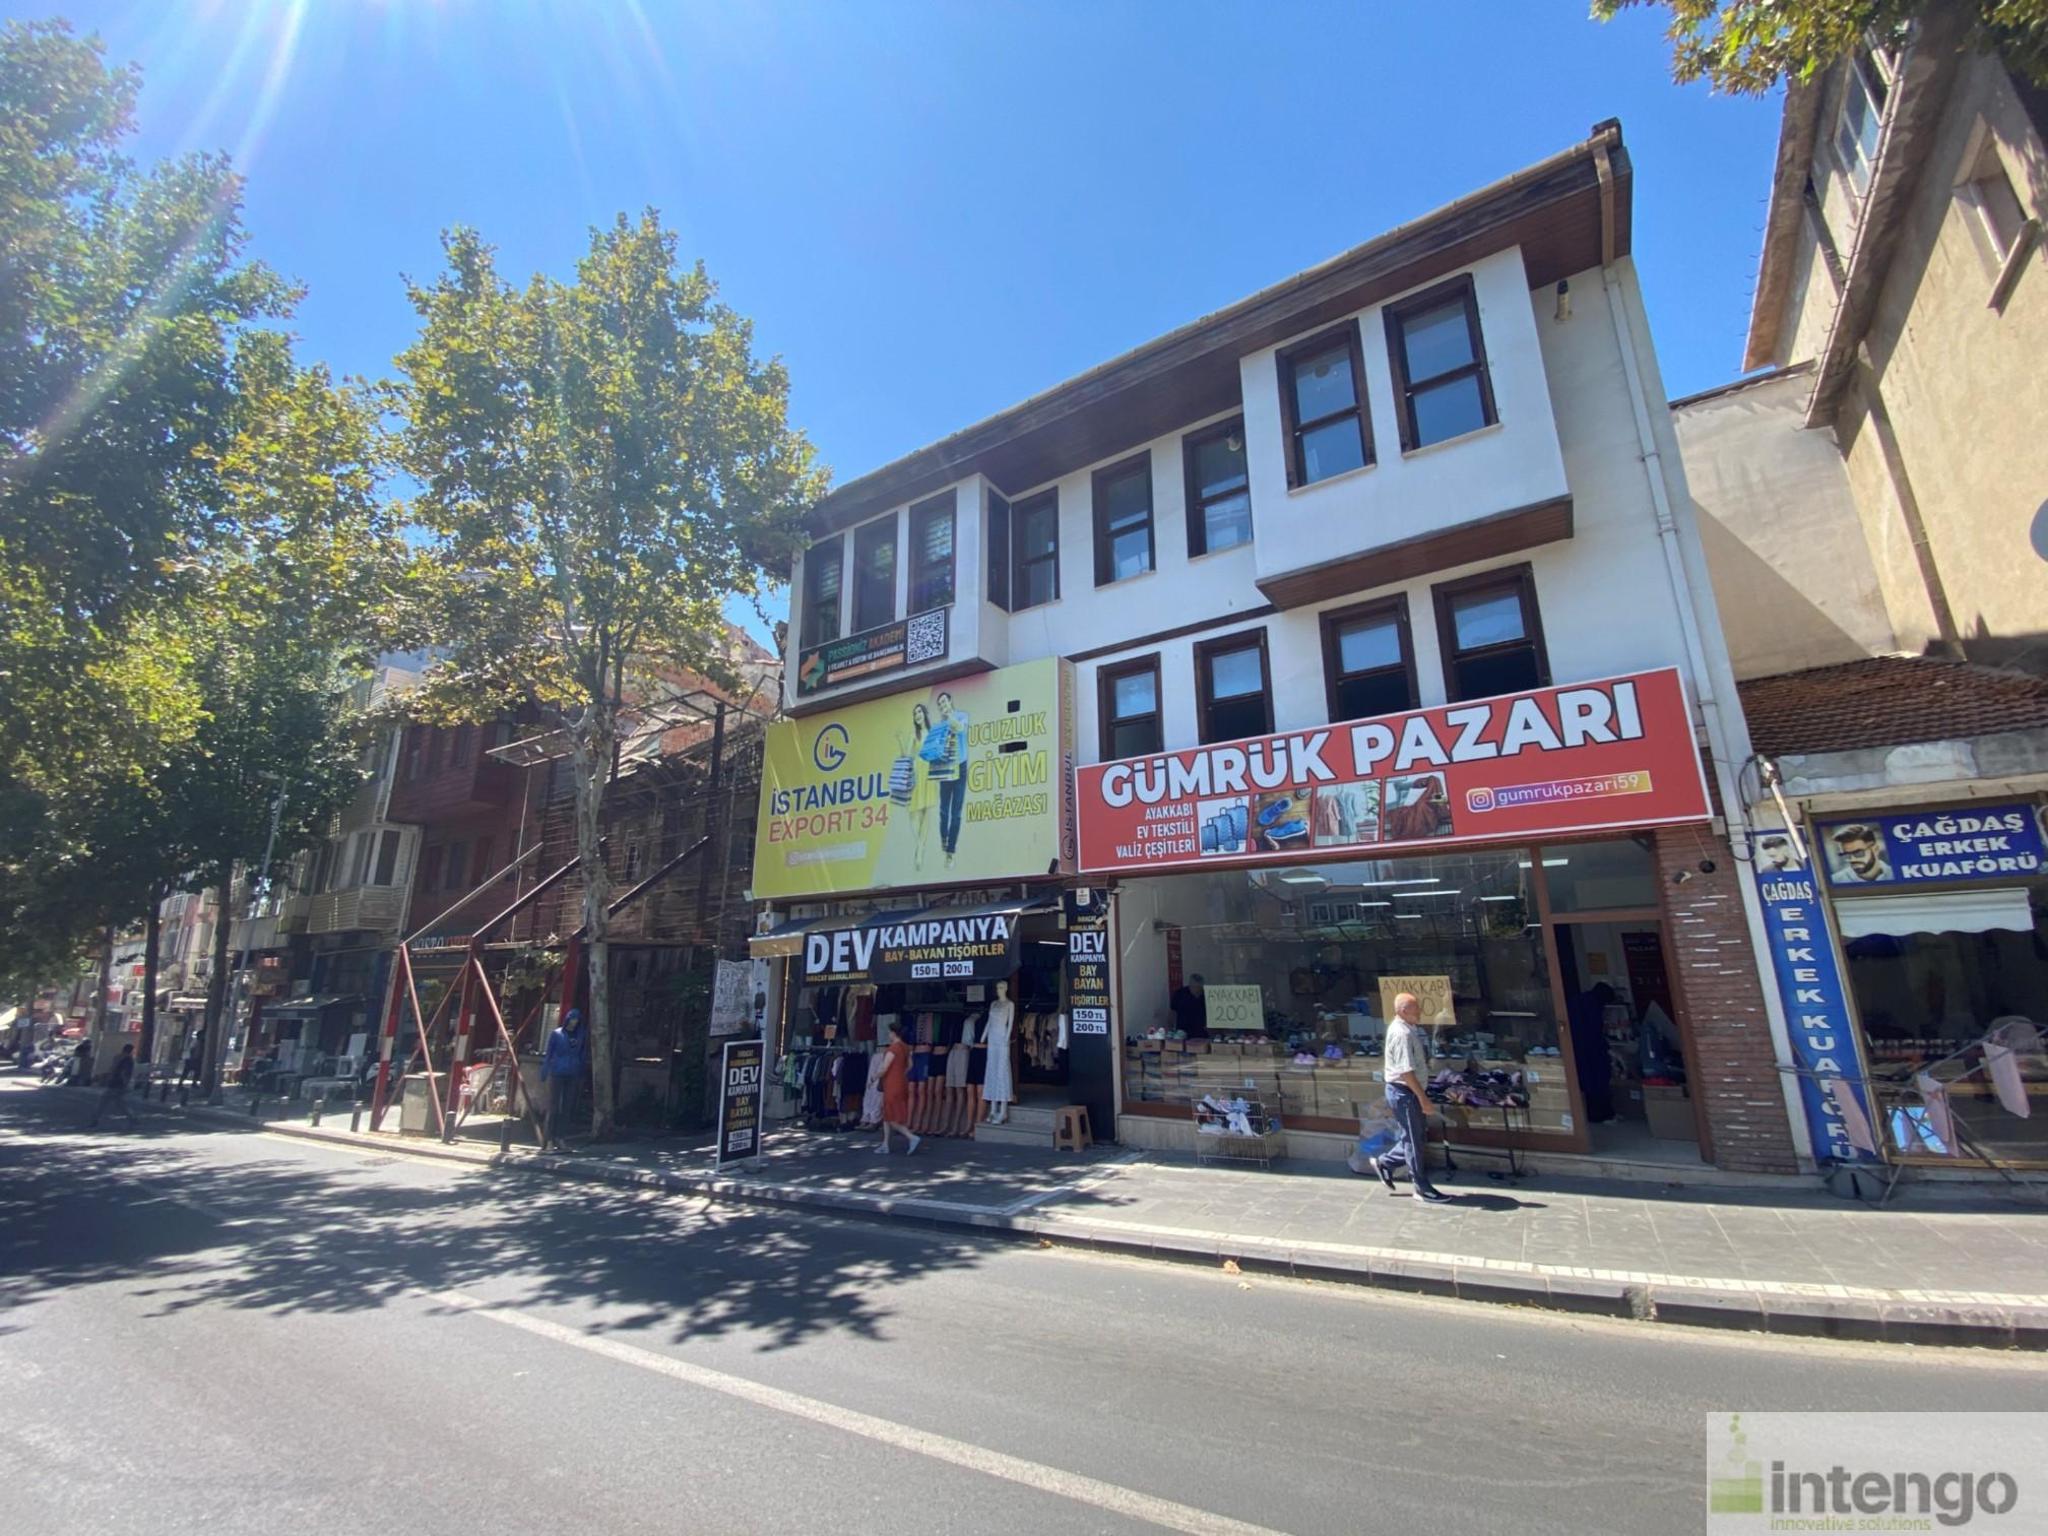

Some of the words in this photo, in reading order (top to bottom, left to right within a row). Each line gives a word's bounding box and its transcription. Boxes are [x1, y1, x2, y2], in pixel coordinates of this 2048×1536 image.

[967, 712, 1047, 747] UCUZLUK
[1101, 731, 1337, 808] GÜMRÜK
[1351, 680, 1644, 776] PAZARI
[771, 772, 890, 816] İSTANBUL
[1498, 774, 1640, 806] gumrukpazari59
[966, 793, 1048, 823] MAĞAZASI
[1145, 802, 1194, 820] AYAKKABI
[769, 808, 857, 842] EXPORT
[861, 804, 889, 829] 34
[1137, 825, 1149, 839] EV
[1151, 817, 1195, 837] TEKSTİLİ
[1892, 813, 2025, 843] ÇAĞDAŞ
[1116, 841, 1142, 859] VALİZ
[1145, 835, 1196, 860] ÇEŞİTLERİ
[1918, 836, 2011, 857] ERKEK
[1901, 851, 2038, 878] KUAFÖRÜ
[1762, 877, 1814, 907] ÇAĞDAŞ
[806, 927, 878, 975] DEV
[879, 915, 1010, 949] KAMPANYA
[948, 943, 1005, 960] TİŞÖRTLER
[1069, 931, 1106, 954] DEV
[1070, 953, 1106, 963] KAMPANYA
[1779, 907, 1826, 1003] ERKEK
[914, 965, 931, 976] 150
[945, 963, 963, 975] 200
[1080, 965, 1097, 977] BAY
[1073, 978, 1104, 990] BAYAN
[1382, 979, 1450, 998] AYAKKABI
[1076, 1010, 1093, 1019] 150
[1215, 1005, 1248, 1021] 200
[1075, 1023, 1094, 1032] 200
[729, 1066, 760, 1086] DEV
